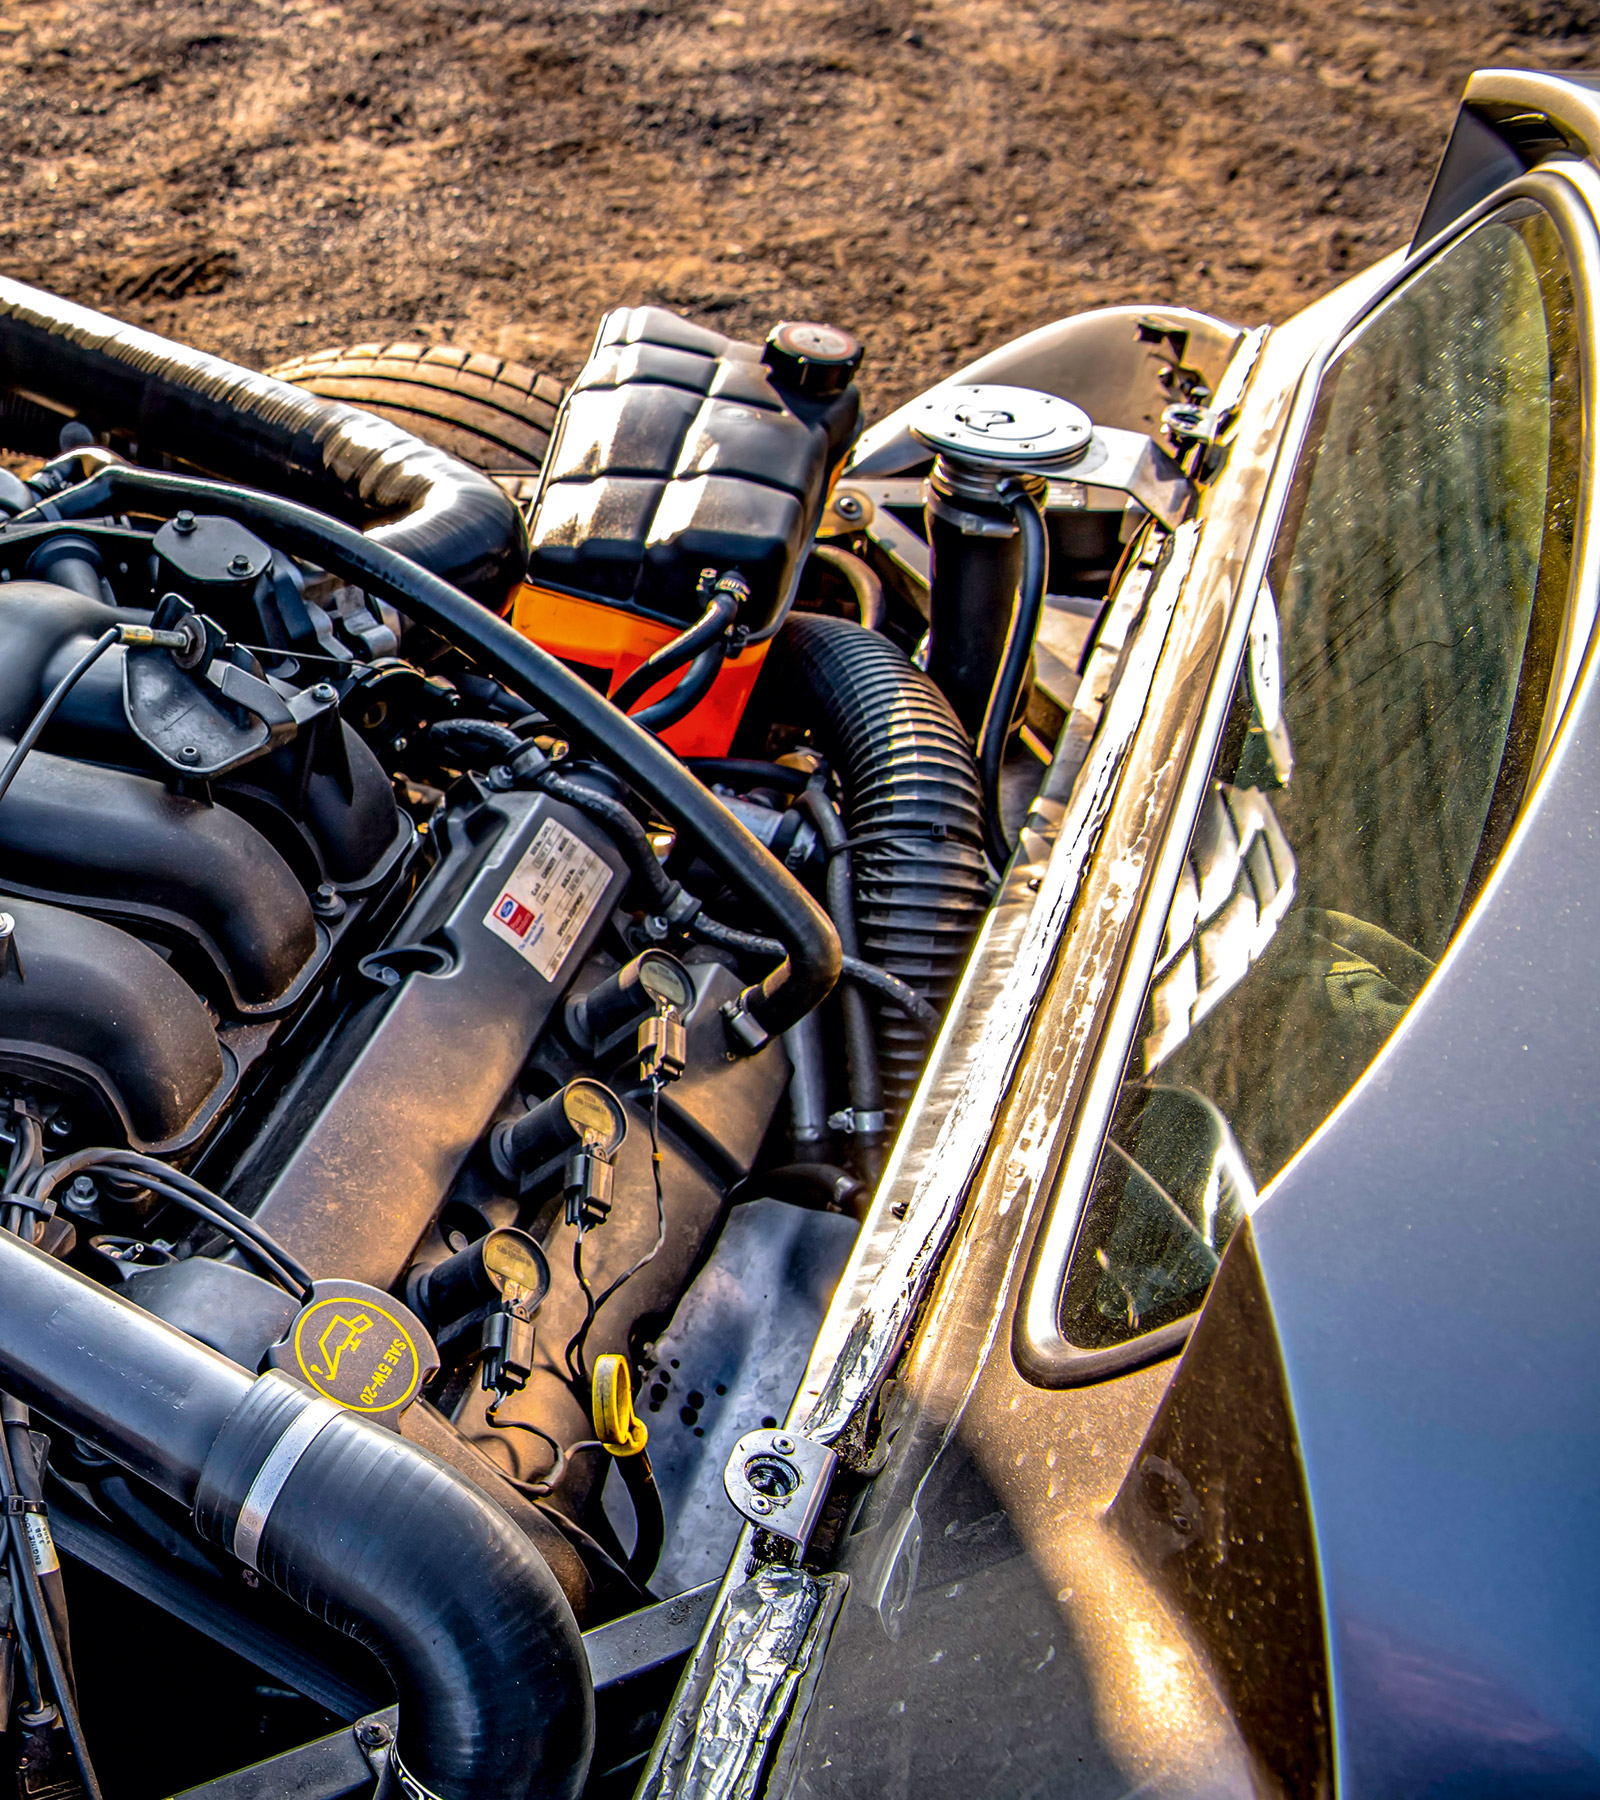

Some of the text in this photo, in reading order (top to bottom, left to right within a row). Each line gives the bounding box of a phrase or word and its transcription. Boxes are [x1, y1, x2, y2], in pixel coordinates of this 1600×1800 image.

[359, 1338, 407, 1405] SAE 5W-20
[28, 1536, 42, 1566] ENGINE
